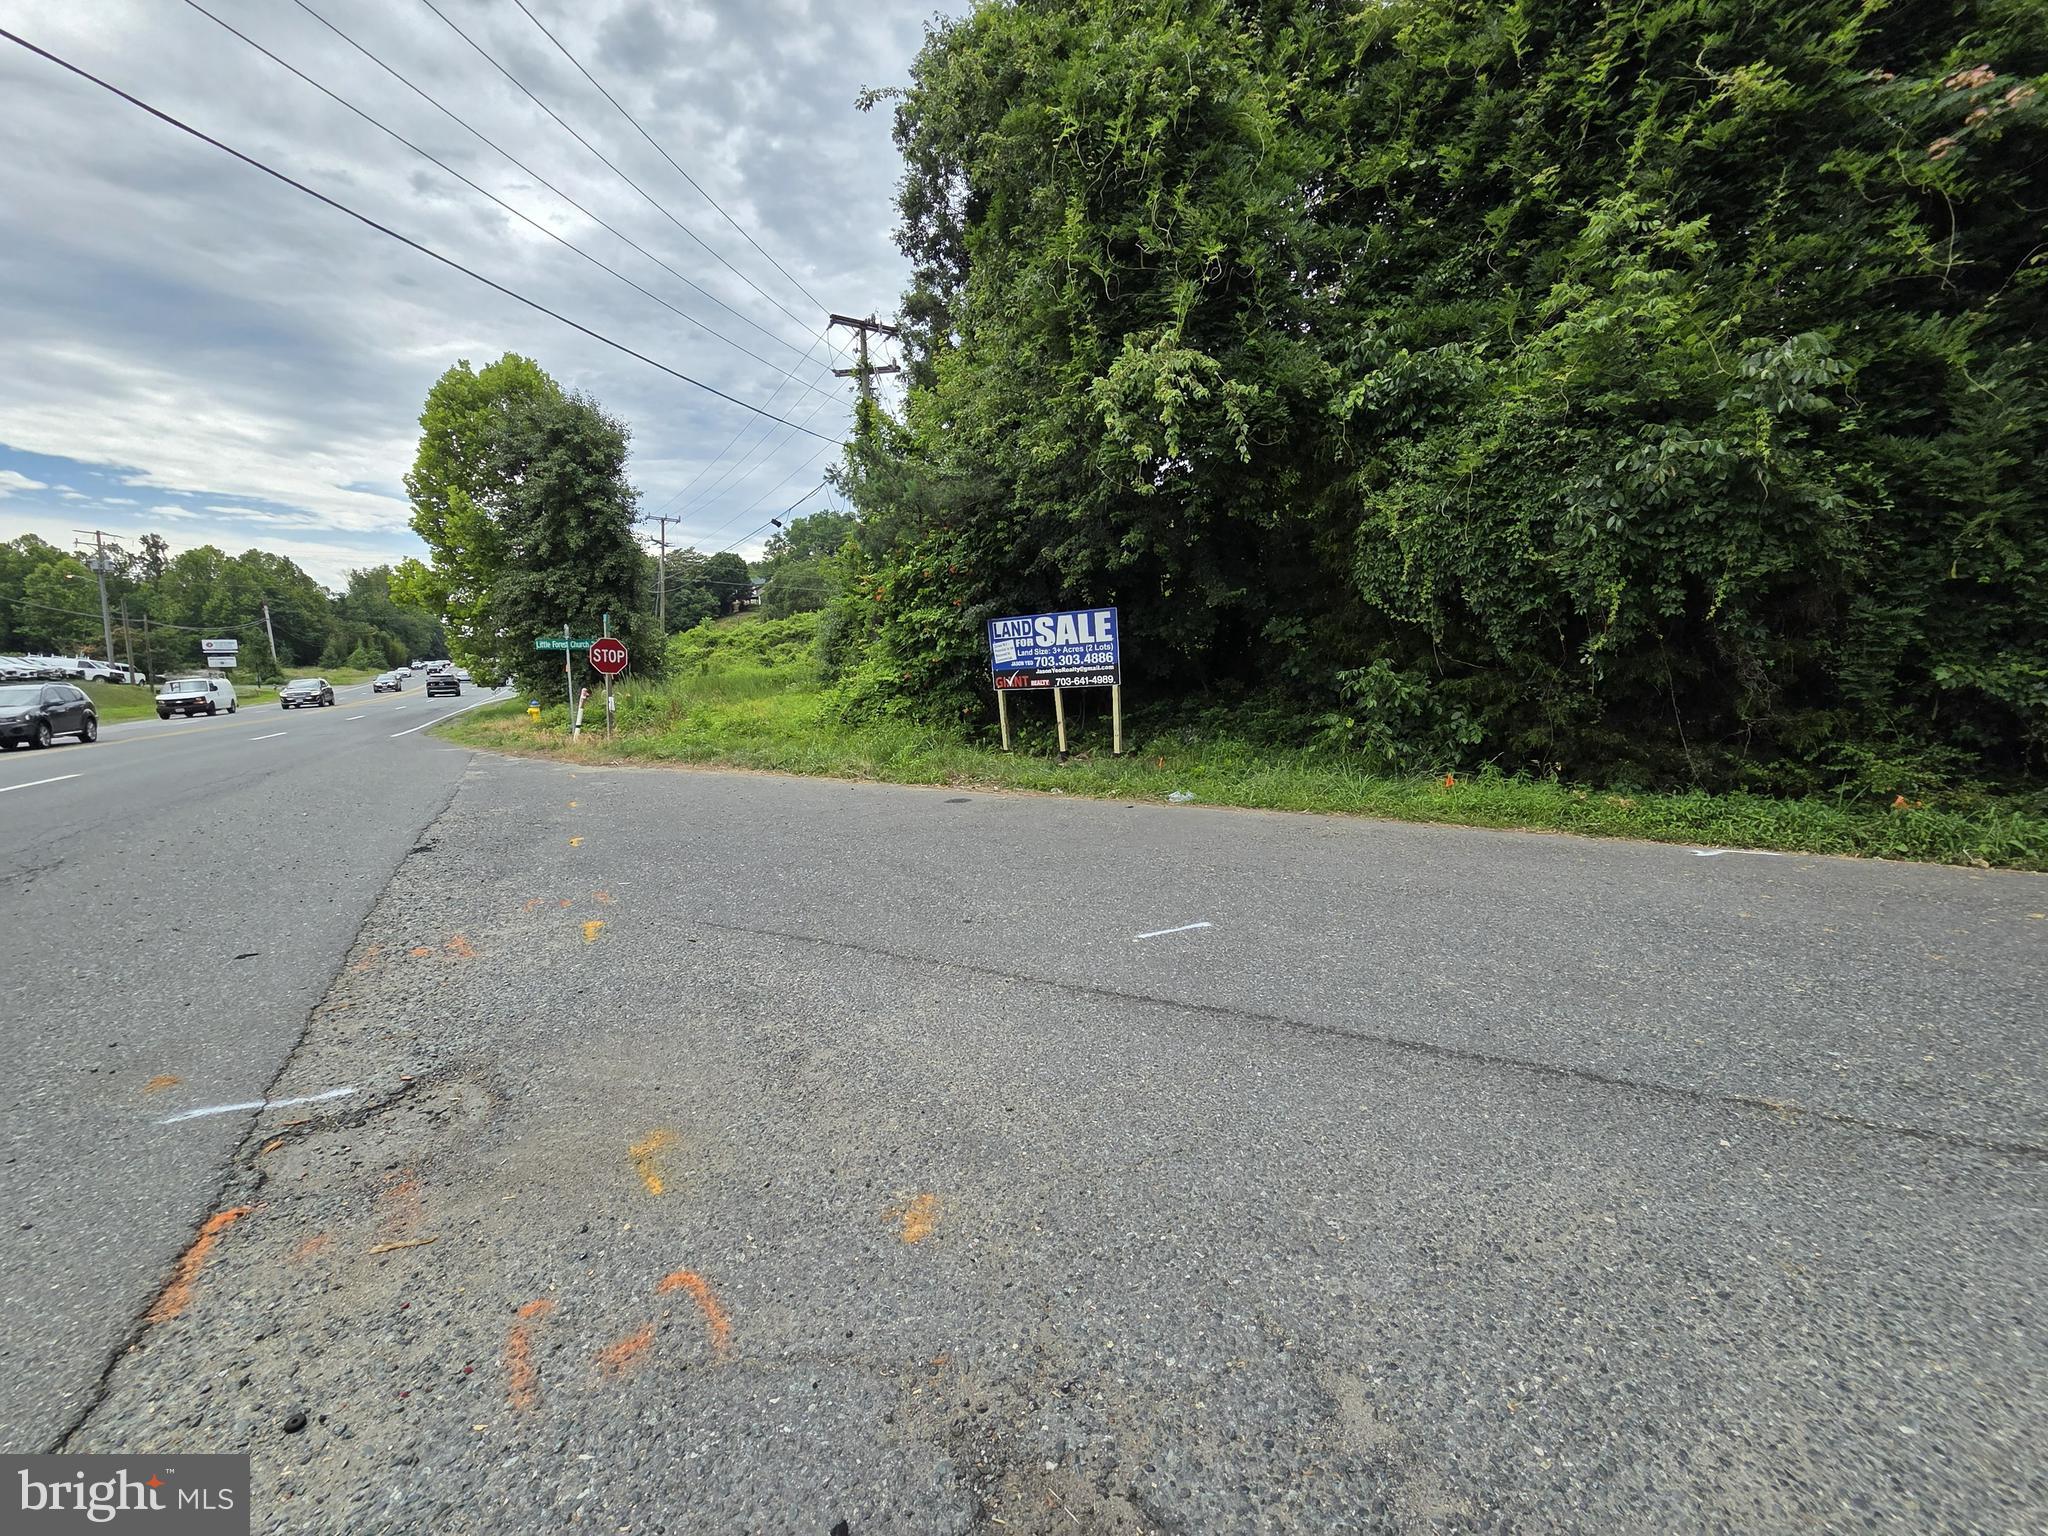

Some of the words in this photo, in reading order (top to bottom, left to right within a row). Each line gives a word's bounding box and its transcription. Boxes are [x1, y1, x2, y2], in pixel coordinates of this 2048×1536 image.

[994, 620, 1031, 638] LAND
[1015, 638, 1034, 647] FOR
[1035, 611, 1114, 647] SALE
[593, 648, 625, 663] STOP
[1017, 648, 1033, 656] Land
[1034, 647, 1051, 655] Size:
[1052, 646, 1061, 654] 3+
[1062, 645, 1084, 653] Acres
[1085, 644, 1093, 653] (2
[1095, 642, 1114, 651] Lots)
[1034, 652, 1114, 667] 703.303.4886
[1055, 675, 1114, 686] 703-641-4989
